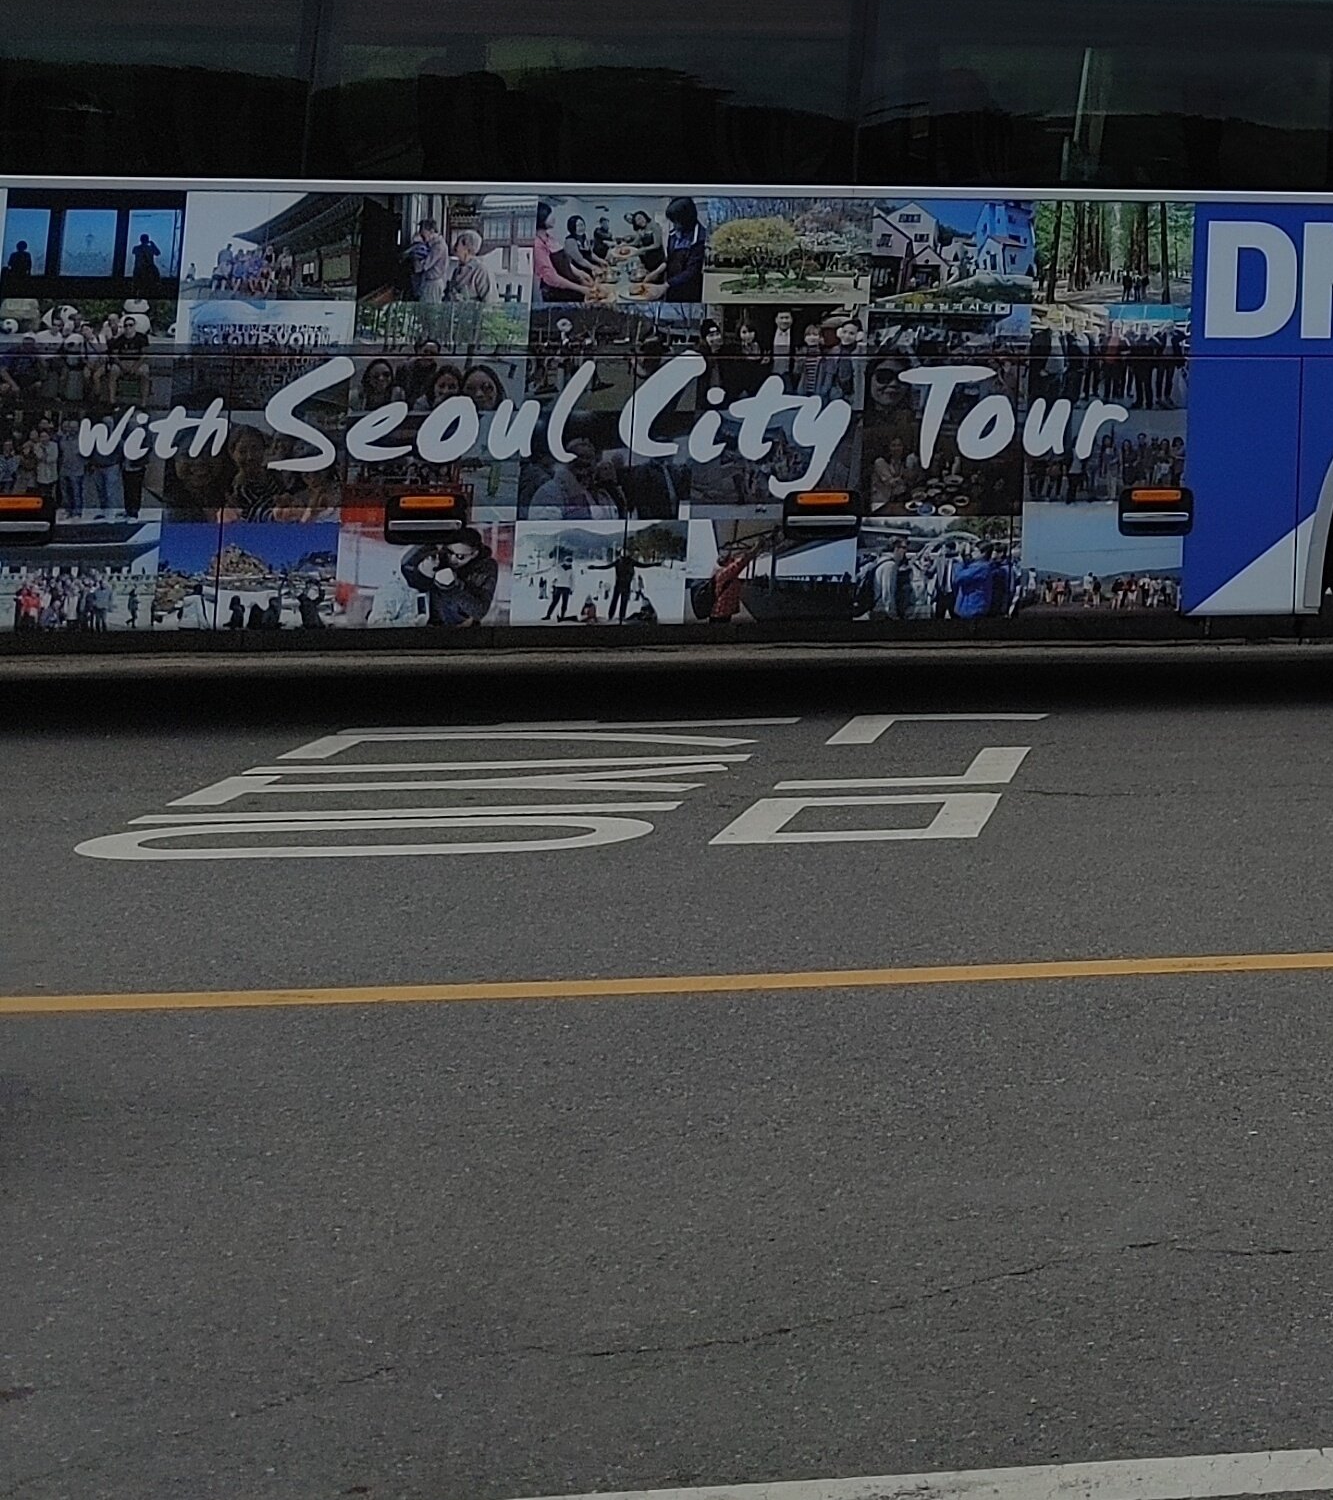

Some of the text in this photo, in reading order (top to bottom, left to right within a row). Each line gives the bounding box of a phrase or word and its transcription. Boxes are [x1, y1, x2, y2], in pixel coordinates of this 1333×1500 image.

[78, 351, 1129, 499] with Seoul City Tour
